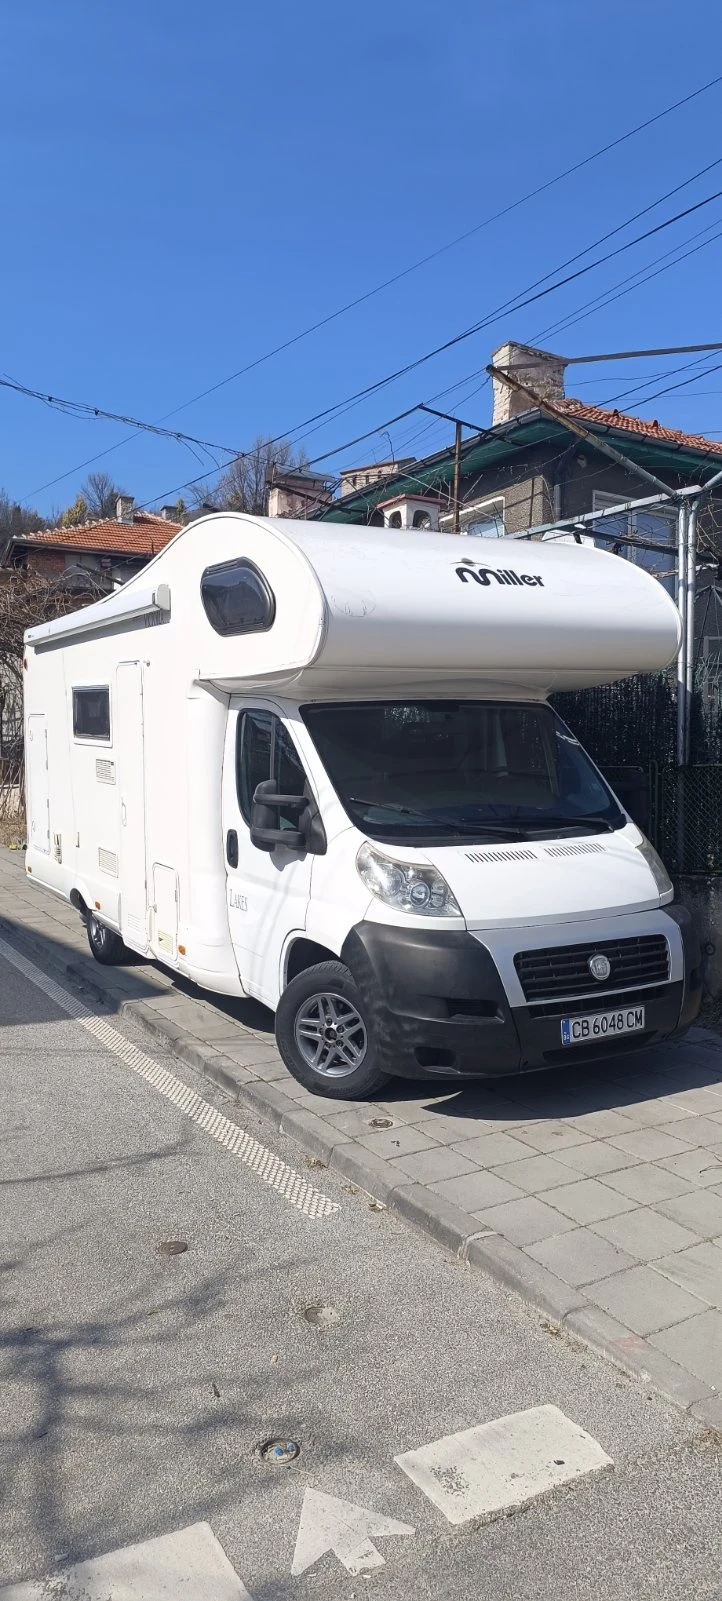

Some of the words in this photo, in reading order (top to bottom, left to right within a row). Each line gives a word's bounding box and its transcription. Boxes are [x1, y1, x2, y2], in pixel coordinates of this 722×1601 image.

[455, 567, 545, 587] Miller
[572, 1019, 590, 1039] CB
[593, 1013, 624, 1035] 6048
[626, 1009, 643, 1028] CM
